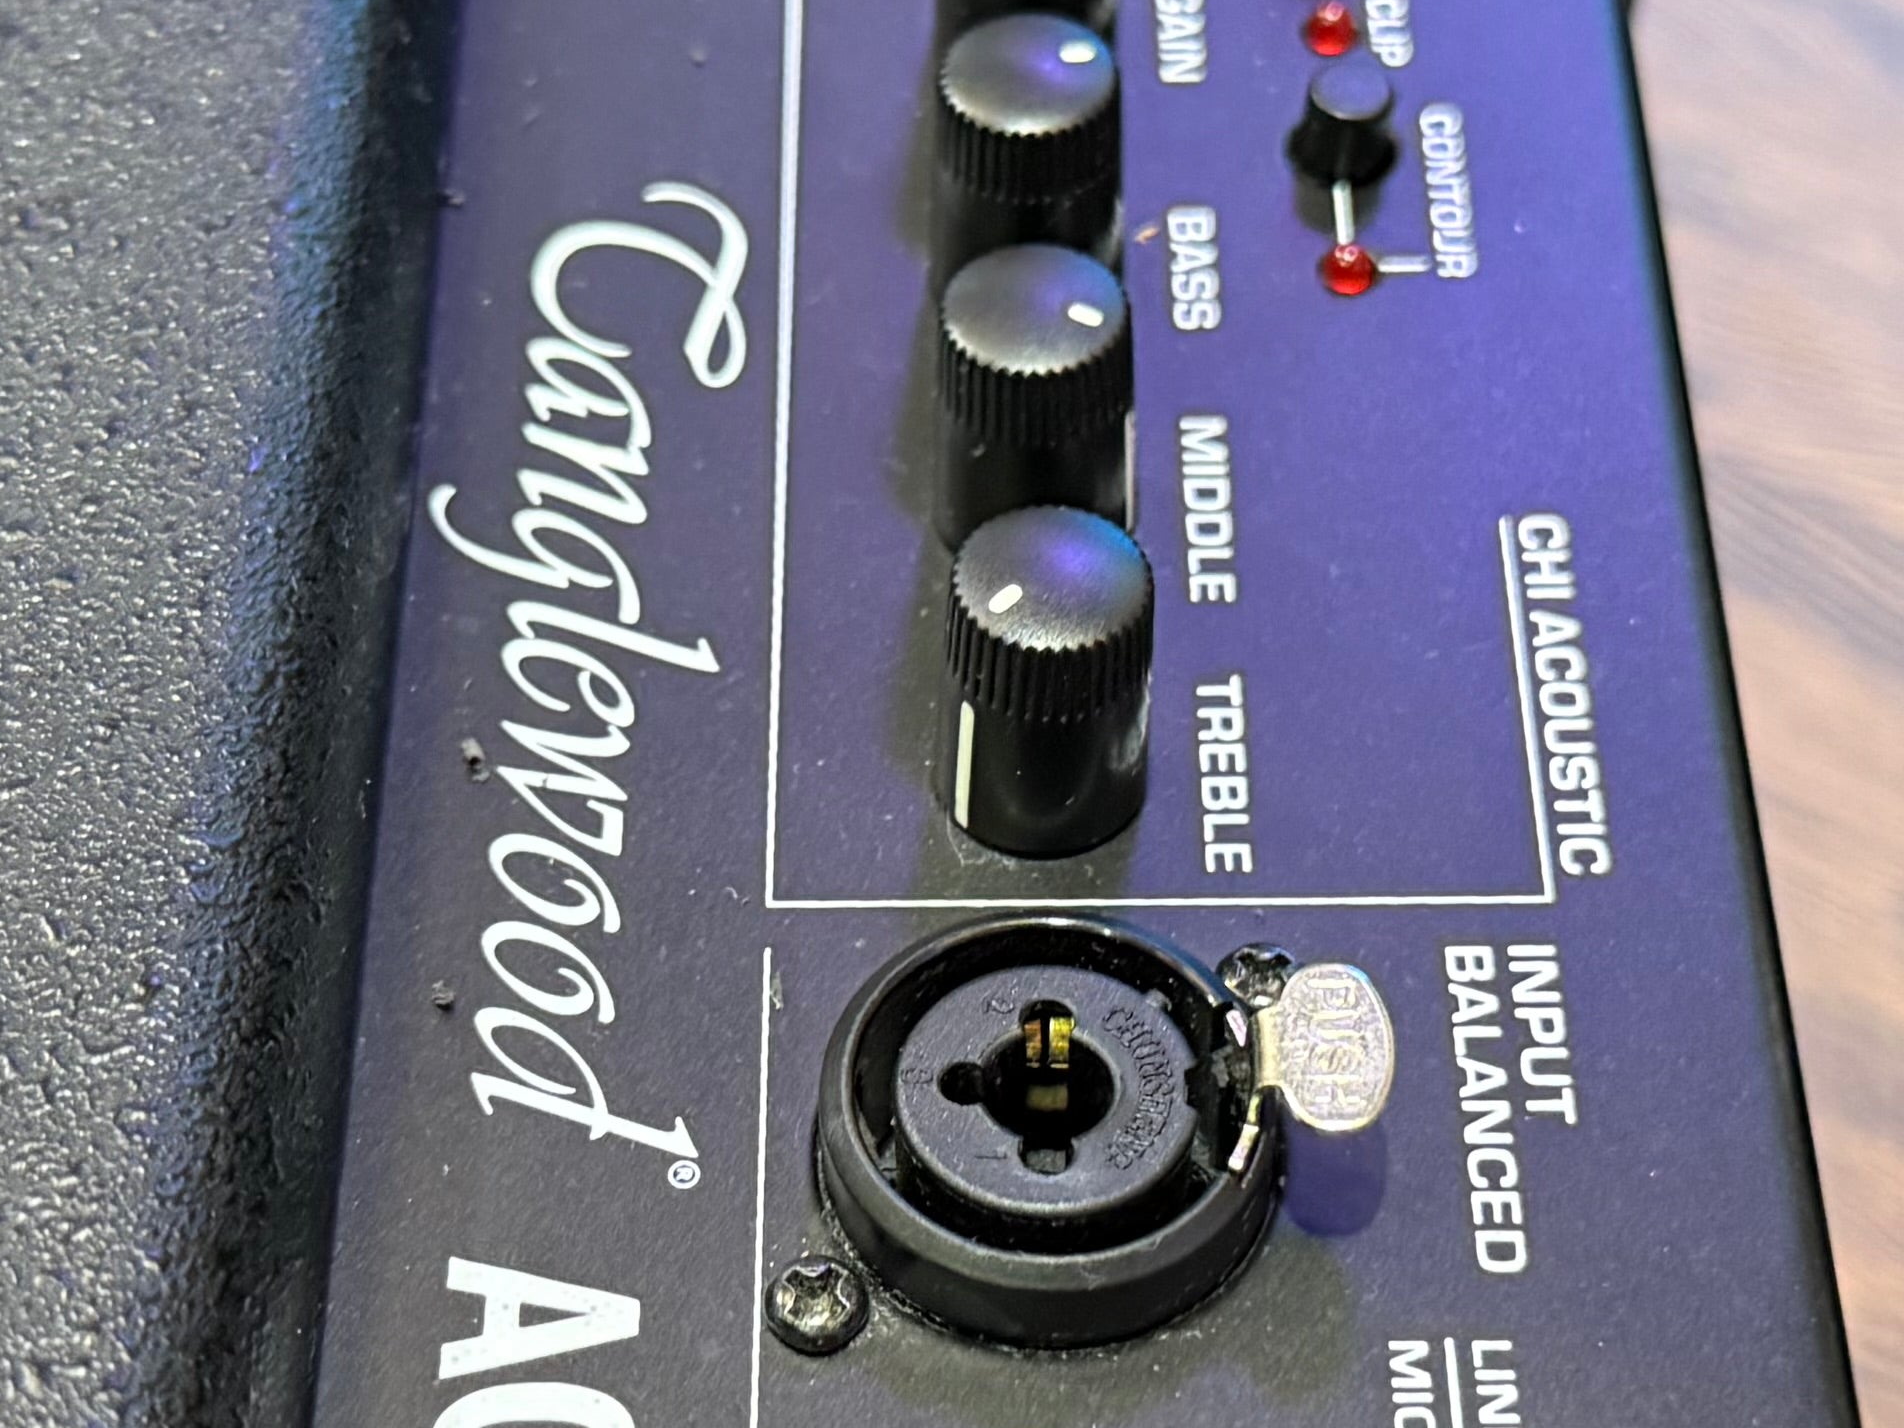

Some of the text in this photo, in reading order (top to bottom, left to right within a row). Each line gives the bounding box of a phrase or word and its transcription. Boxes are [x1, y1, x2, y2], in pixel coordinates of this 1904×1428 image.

[1167, 206, 1221, 331] BASS
[1419, 102, 1477, 278] CONTOUR
[1179, 415, 1236, 603] MIDDLE
[1195, 673, 1253, 873] TREBLE
[1529, 609, 1612, 875] ACOUSTIC
[1444, 944, 1528, 1273] BALANCED
[1506, 944, 1577, 1125] INPUT
